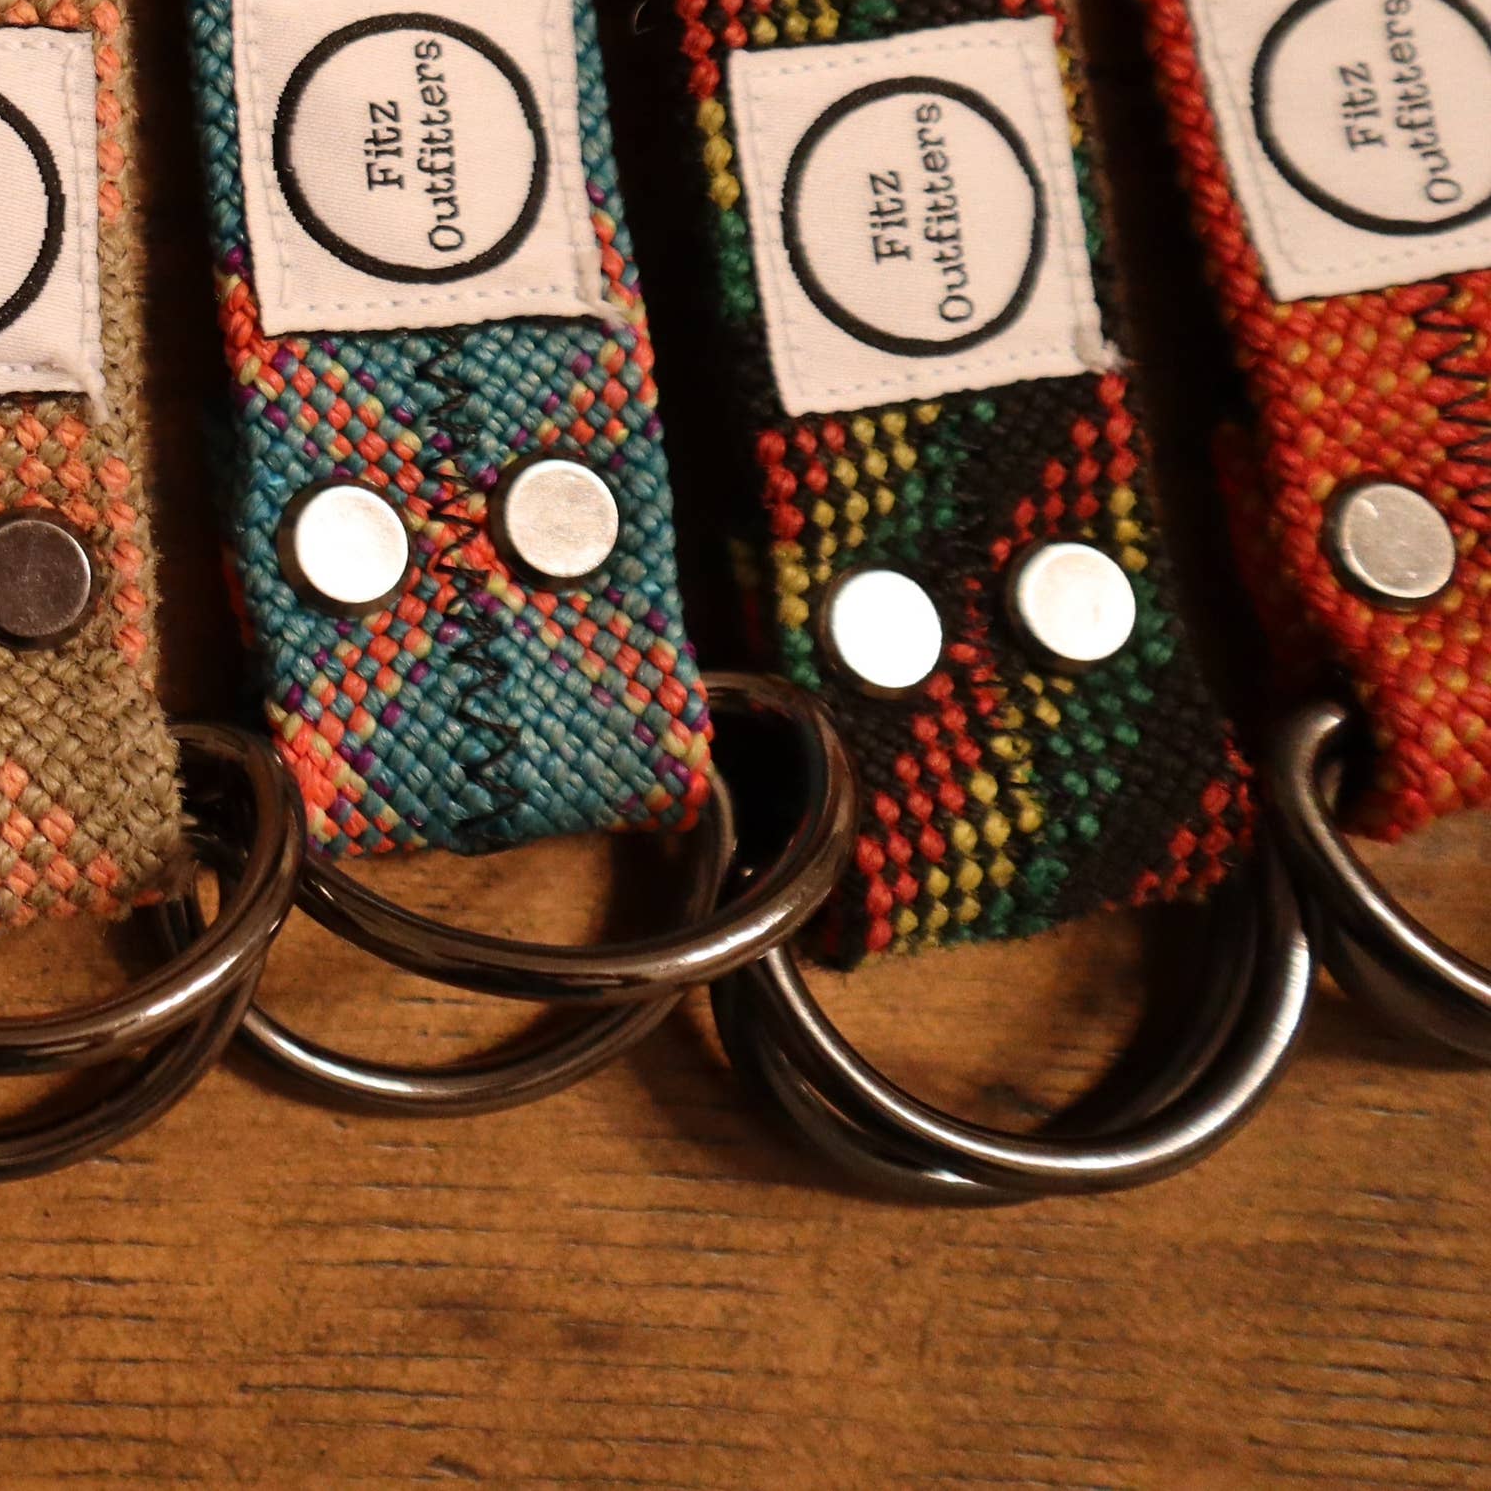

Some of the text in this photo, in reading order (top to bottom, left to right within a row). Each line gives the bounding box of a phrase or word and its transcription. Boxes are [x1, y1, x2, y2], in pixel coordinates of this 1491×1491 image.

[364, 100, 405, 192] Fitz
[413, 39, 465, 253] Outfitters
[1339, 62, 1385, 153] Fitz
[869, 170, 912, 266] Fitz
[915, 102, 974, 324] Outfitters
